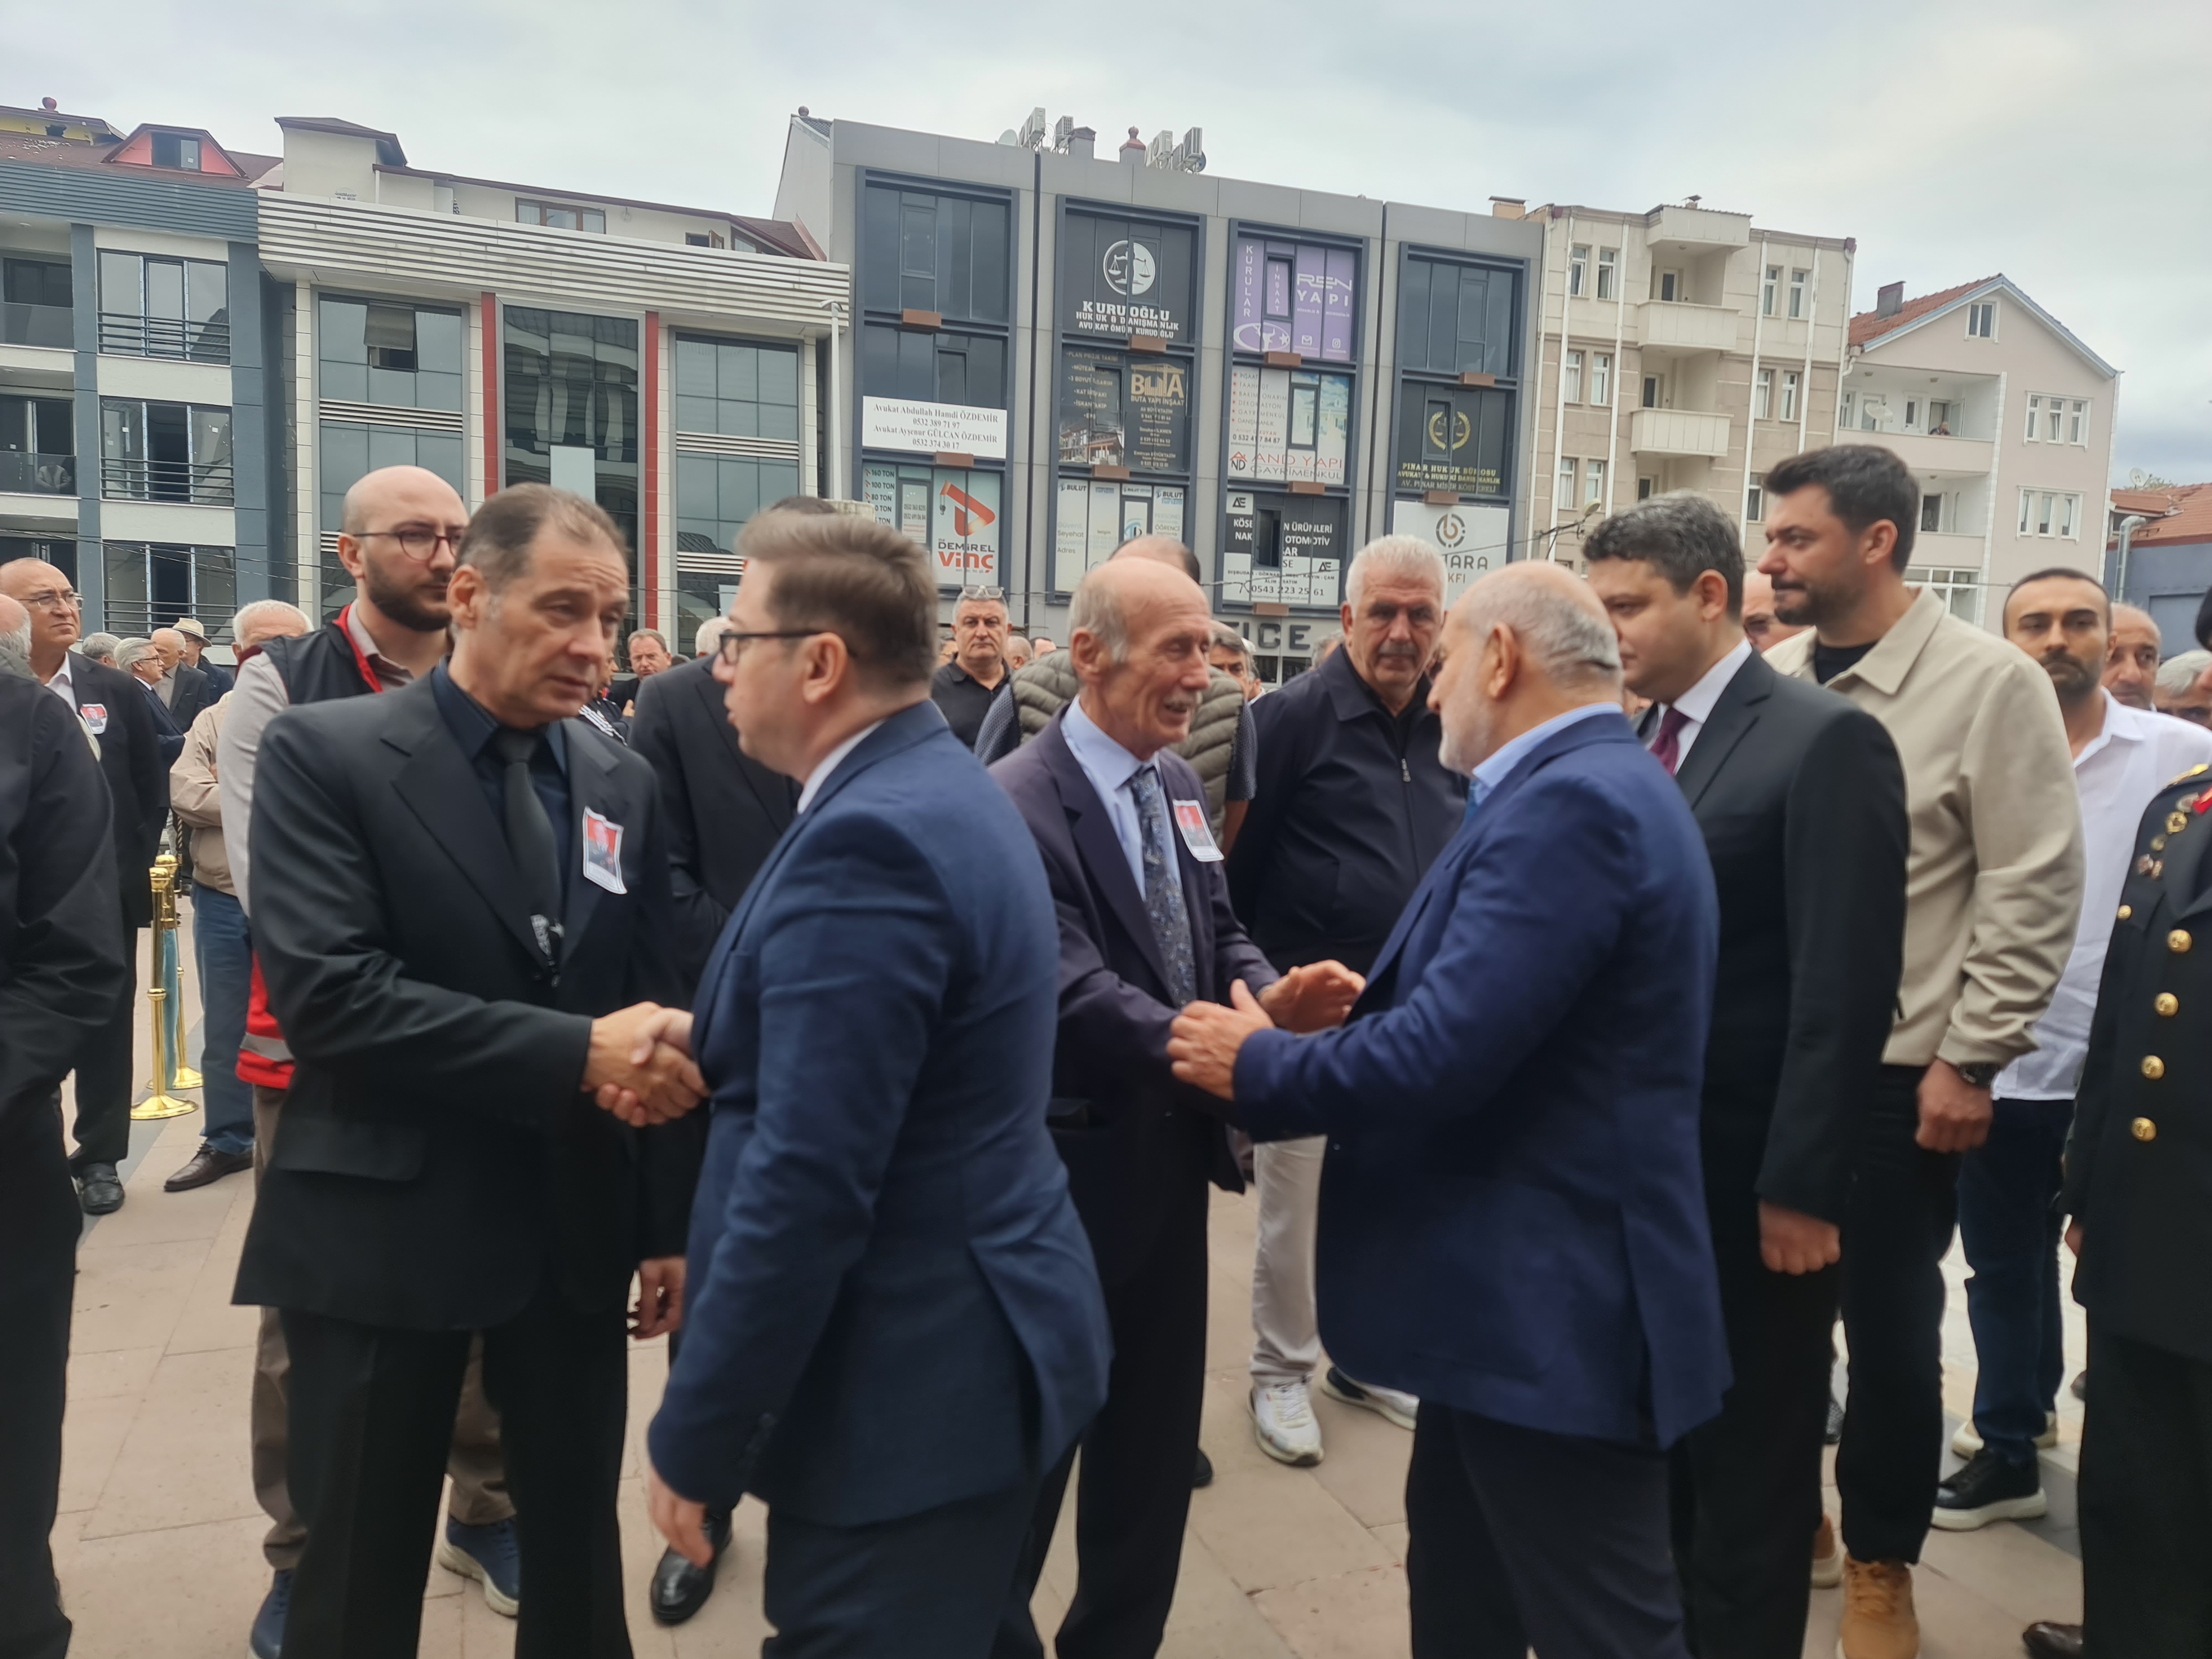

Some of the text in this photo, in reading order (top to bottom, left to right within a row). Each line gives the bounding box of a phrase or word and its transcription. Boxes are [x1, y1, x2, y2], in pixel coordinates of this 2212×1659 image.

[1244, 245, 1253, 317] KURULAR
[1297, 273, 1352, 291] REN
[1297, 289, 1349, 306] YAPI
[1083, 301, 1170, 321] KURUOĞLU
[1076, 311, 1107, 322] HUKUK
[1120, 316, 1178, 331] DANIŞMANLIK
[1078, 321, 1109, 331] AVUKAT
[1131, 395, 1146, 403] BUTA
[874, 403, 998, 423] Avukat Abdullah Hamdi ÖZDEMİR
[1238, 409, 1285, 419] GAYRMENKUL
[912, 418, 928, 426] 0532
[930, 419, 941, 427] 389
[874, 425, 997, 443] Avukat Ayşenur GÜLCAN ÖZDEMİR
[912, 438, 927, 446] 0532
[1252, 453, 1296, 465] AND
[1302, 456, 1342, 469] YAPI
[1402, 462, 1428, 472] PINAR
[1431, 465, 1460, 474] HUKUK
[1292, 521, 1332, 533] ÜRÜNLERİ
[1285, 535, 1330, 546] OTOMOTİV
[1445, 554, 1488, 570] ARA
[1251, 585, 1274, 594] 0543
